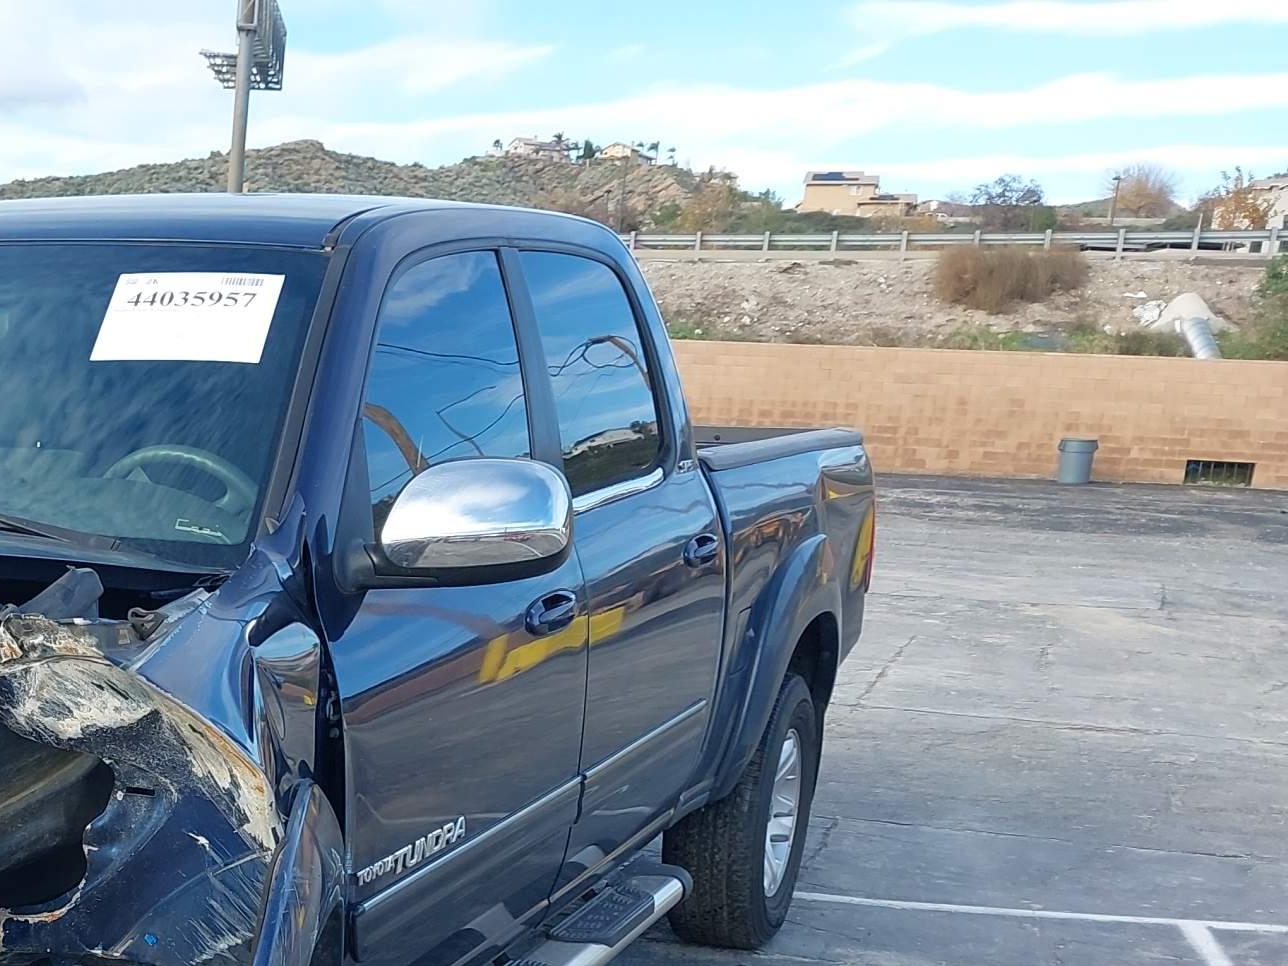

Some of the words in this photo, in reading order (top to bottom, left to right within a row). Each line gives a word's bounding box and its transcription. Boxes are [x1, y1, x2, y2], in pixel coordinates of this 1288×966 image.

[126, 290, 258, 308] 44035957
[356, 858, 396, 886] TOYOTA
[394, 815, 467, 875] TUNDRA
